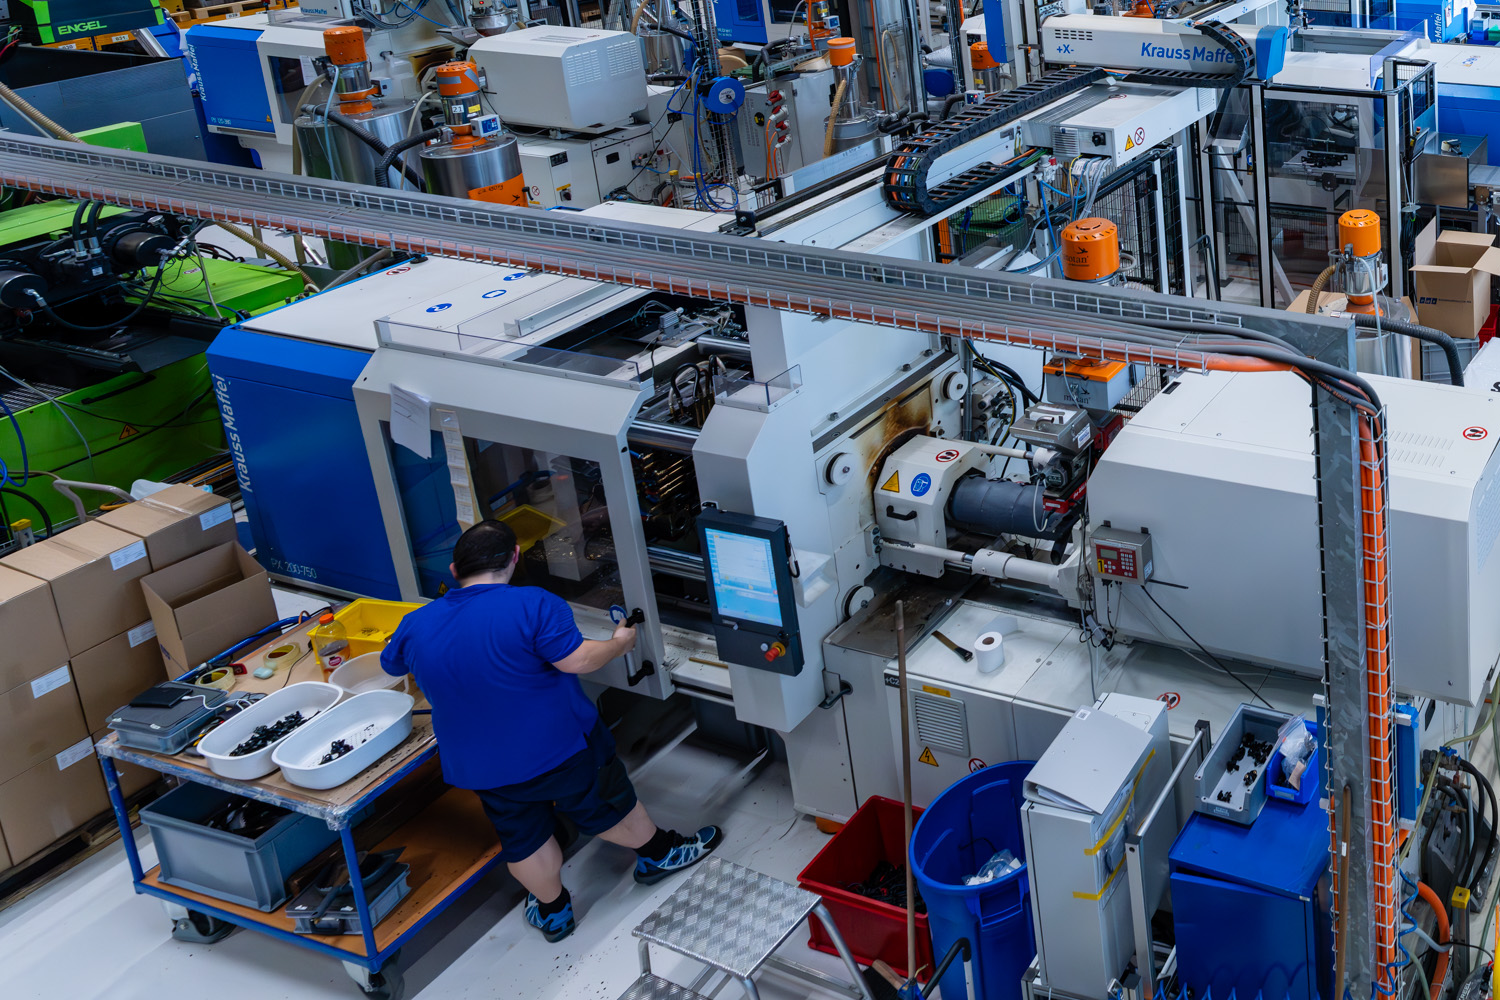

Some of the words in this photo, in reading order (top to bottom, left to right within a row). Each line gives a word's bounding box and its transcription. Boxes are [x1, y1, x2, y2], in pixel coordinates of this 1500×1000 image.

[57, 21, 107, 36] ENGEL
[1141, 42, 1237, 64] KraussMaffe
[188, 43, 208, 102] KraussMaffei
[212, 373, 253, 493] KraussMaffei
[1098, 560, 1104, 573] 1
